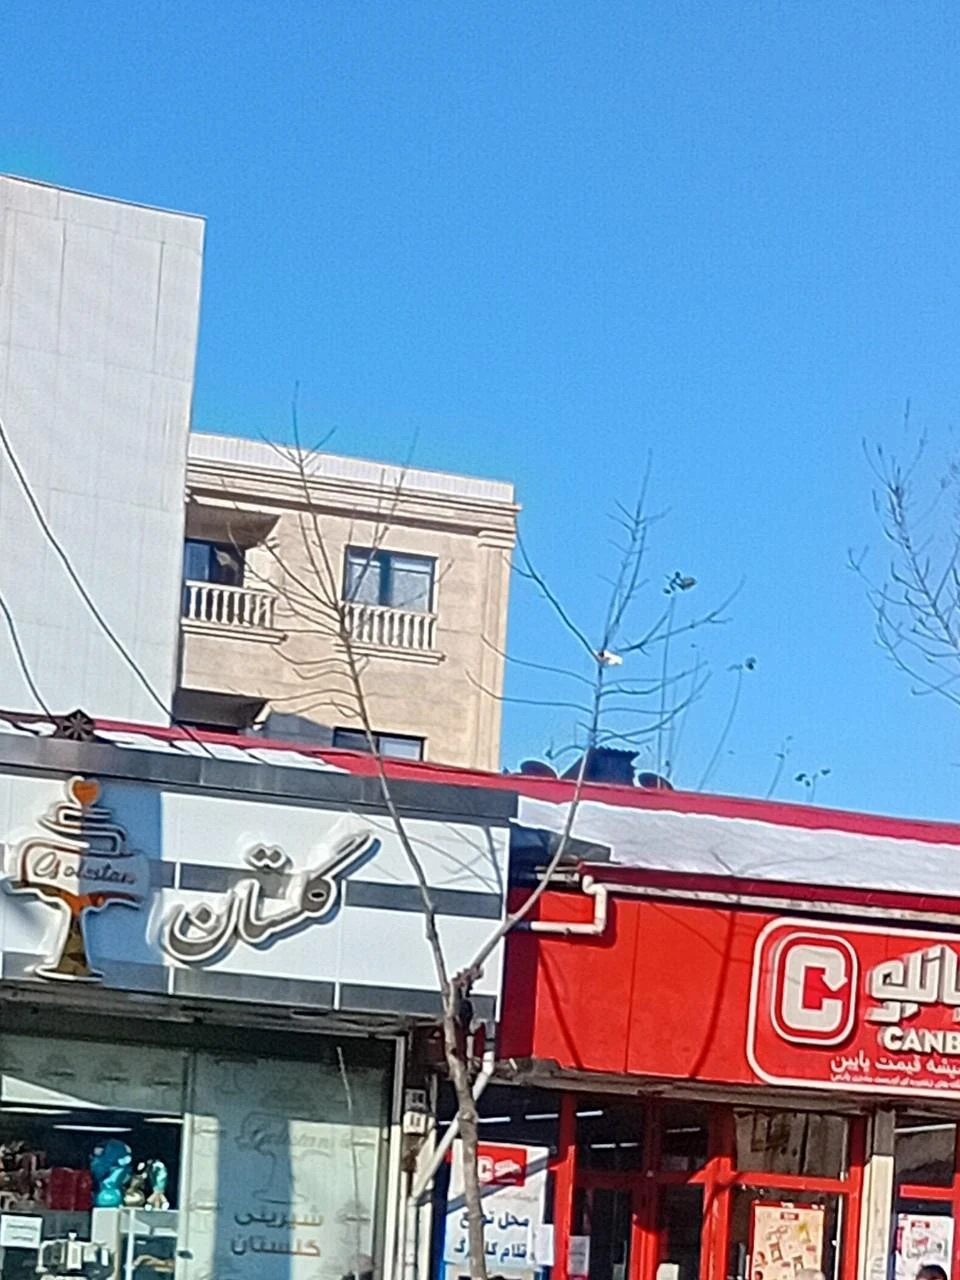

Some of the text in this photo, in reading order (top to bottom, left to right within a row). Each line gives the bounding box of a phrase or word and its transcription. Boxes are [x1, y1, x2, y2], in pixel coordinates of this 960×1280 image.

[158, 822, 381, 967] گلستان
[830, 1050, 871, 1076] پایین
[874, 1053, 922, 1076] قیمت
[233, 1203, 325, 1231] شیرینی
[497, 1210, 531, 1231] محل
